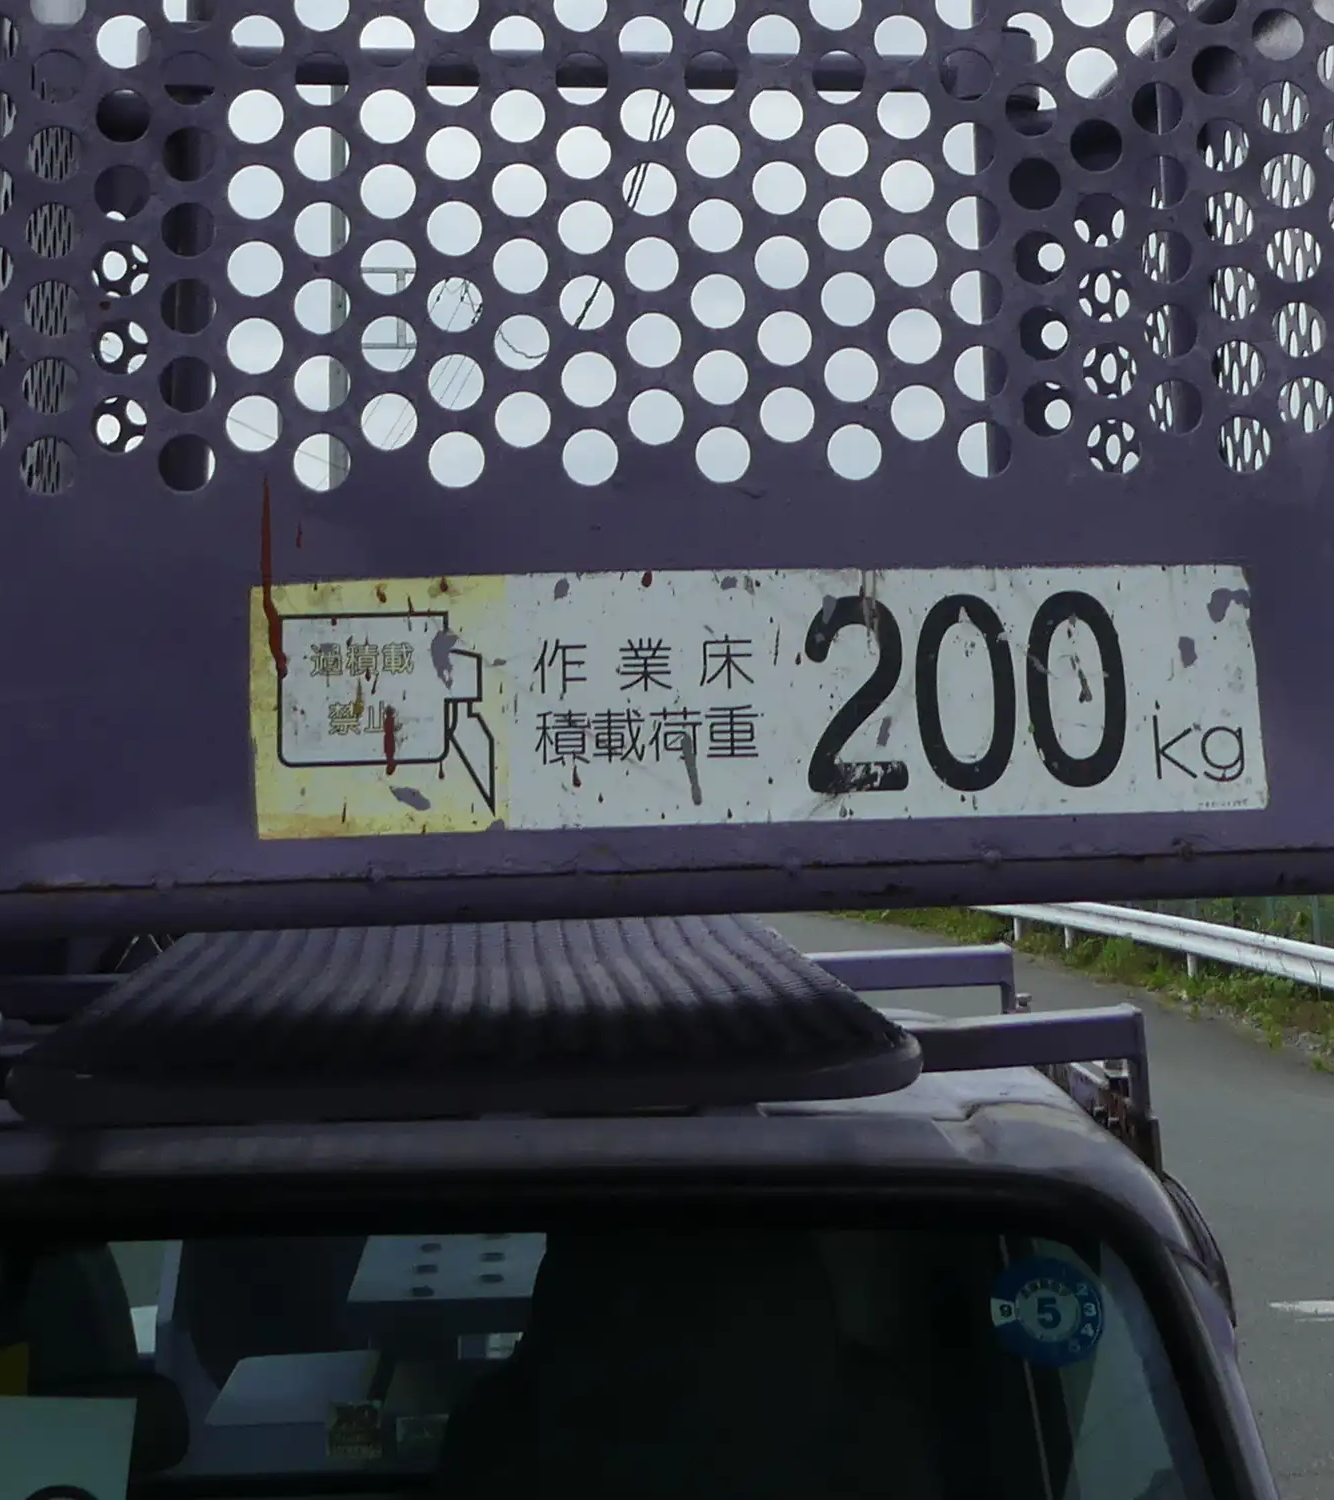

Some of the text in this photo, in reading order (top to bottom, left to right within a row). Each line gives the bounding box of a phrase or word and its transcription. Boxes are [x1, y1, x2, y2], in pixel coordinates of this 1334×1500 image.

[533, 634, 754, 694] 作業床
[805, 590, 1246, 794] 200 kg
[535, 703, 759, 766] 積載荷重
[1036, 1296, 1062, 1329] 5
